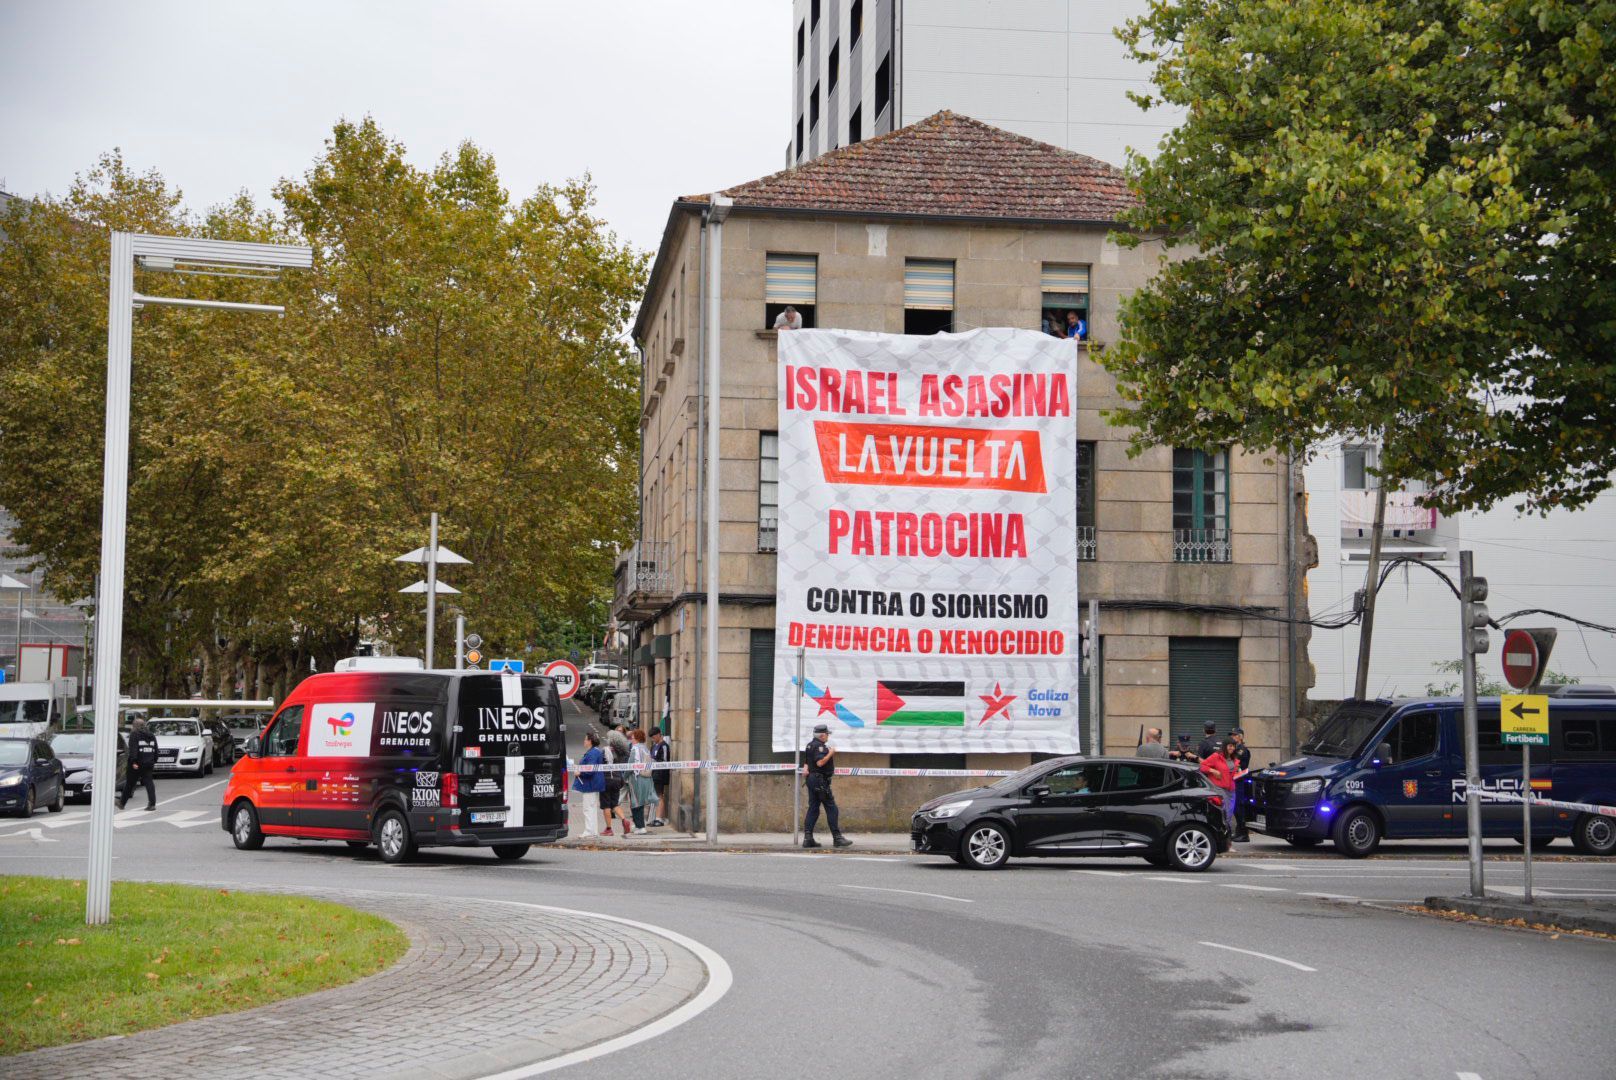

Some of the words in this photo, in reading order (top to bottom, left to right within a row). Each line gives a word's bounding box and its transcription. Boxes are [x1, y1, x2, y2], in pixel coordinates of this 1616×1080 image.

[785, 365, 906, 416] ISRAEL
[919, 372, 1070, 418] ASASINA
[838, 433, 881, 473] LA
[889, 435, 1027, 481] VUELTA
[828, 509, 1027, 558] PATROCINA
[806, 587, 904, 617] CONTRA
[910, 592, 926, 618] O
[932, 593, 1048, 619] SIONISMO
[788, 621, 912, 653] DENUNCIA
[917, 628, 933, 654] O
[939, 629, 1065, 656] XENOCIDIO
[1028, 688, 1069, 702] Galiza
[1028, 704, 1061, 717] Nova
[382, 711, 433, 734] INEOS
[479, 707, 546, 730] INEOS
[380, 737, 431, 747] GRENADIER
[478, 733, 547, 742] GRENADIER
[1506, 734, 1543, 743] Fertiberia
[533, 784, 555, 793] iXION
[1345, 780, 1364, 789] C091
[412, 788, 441, 801] iXION
